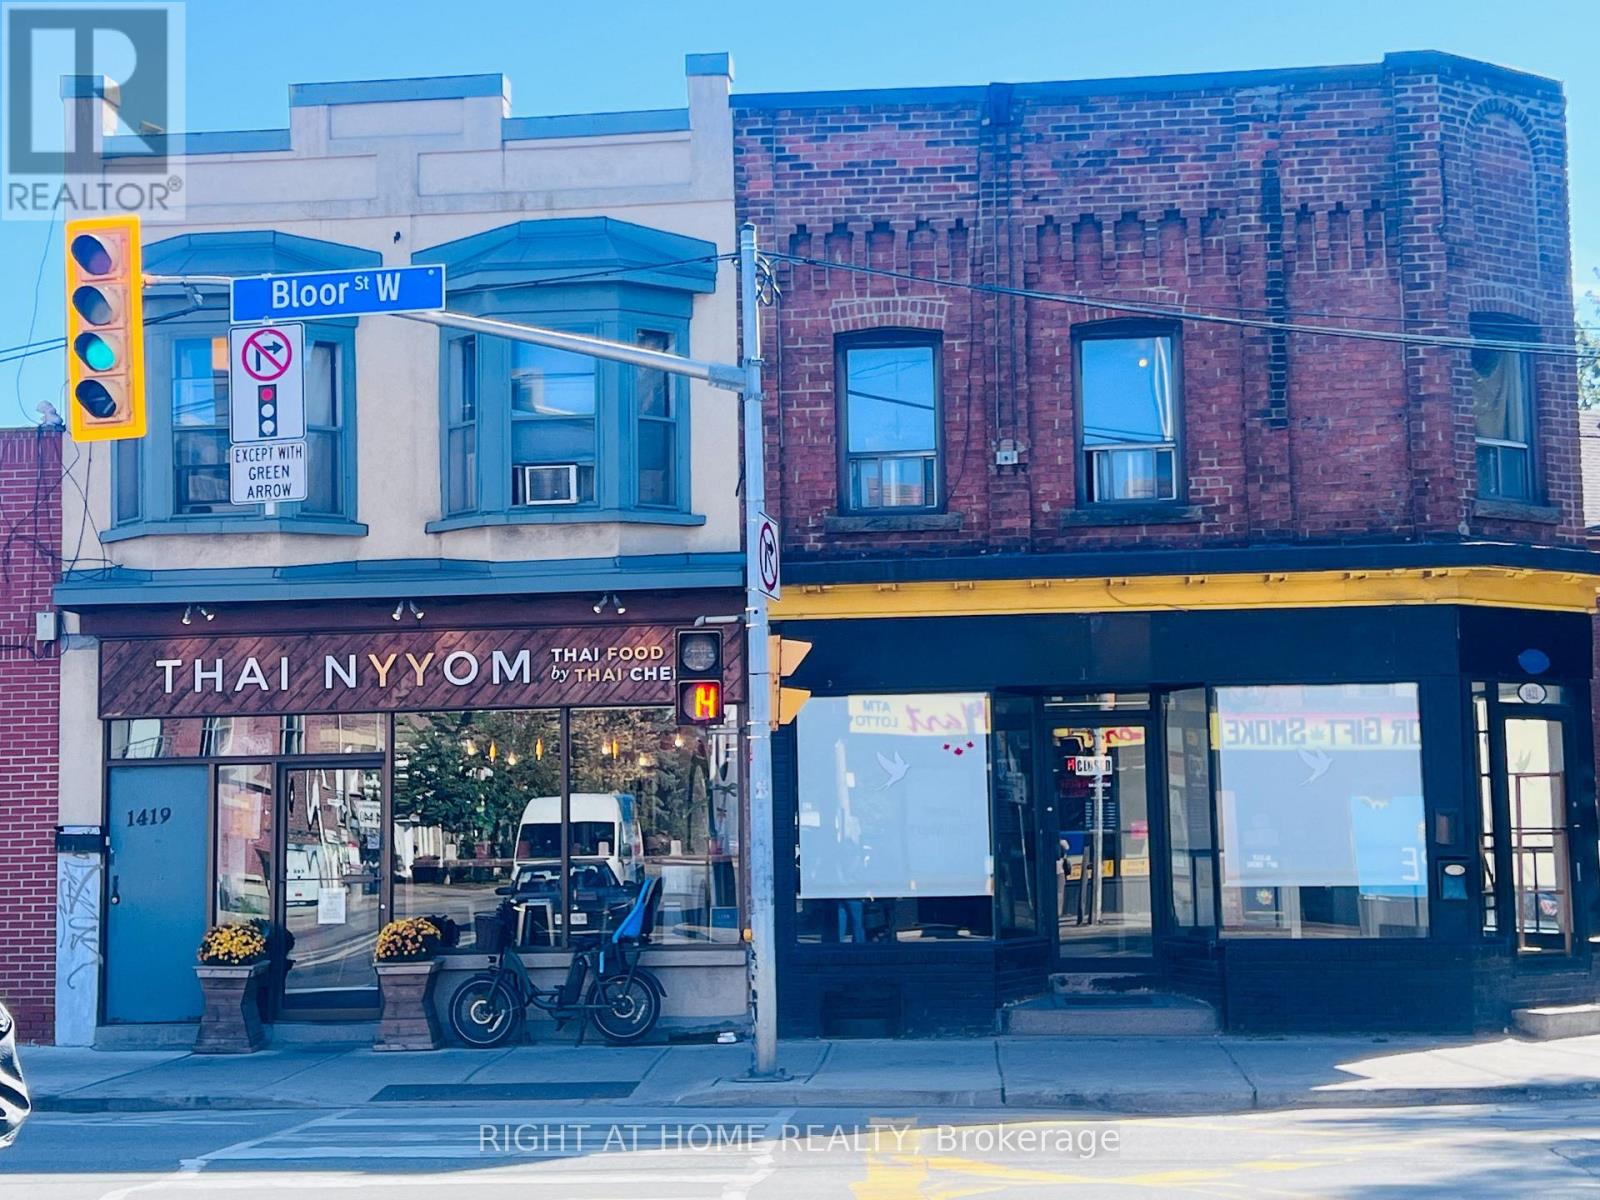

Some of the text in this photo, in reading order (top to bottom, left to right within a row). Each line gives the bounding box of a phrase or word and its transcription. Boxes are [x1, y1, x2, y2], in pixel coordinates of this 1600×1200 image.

[272, 272, 401, 309] Bloor St W
[235, 445, 302, 463] EXCEPT WITH
[248, 465, 290, 481] GREEN
[247, 483, 292, 499] ARROW
[551, 647, 663, 662] THAI FOOD
[155, 649, 532, 694] THAI NYYOM
[551, 665, 676, 683] by THAI CHE
[1077, 759, 1111, 772] CLOSD
[126, 807, 172, 828] 1419
